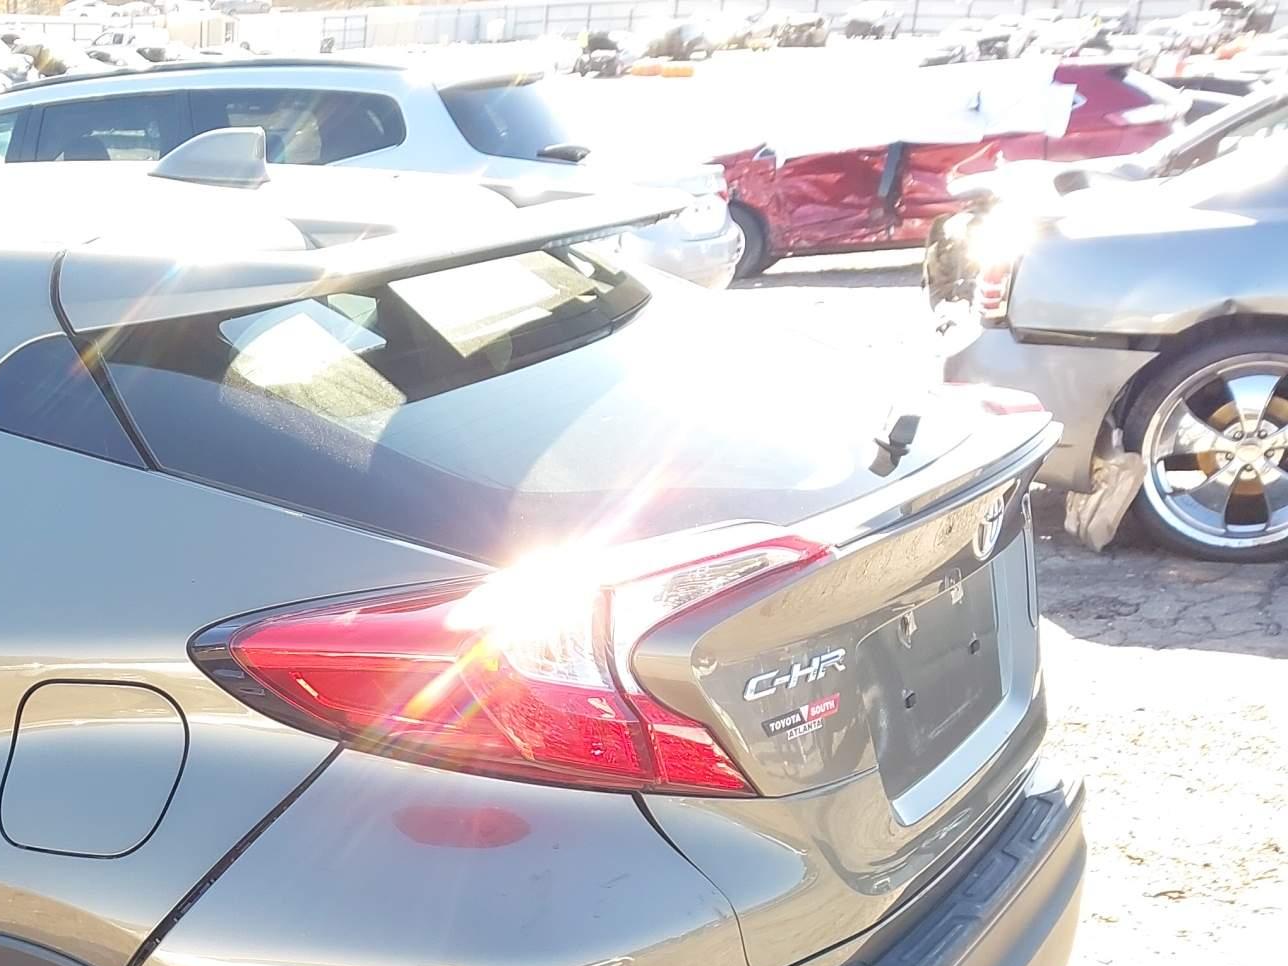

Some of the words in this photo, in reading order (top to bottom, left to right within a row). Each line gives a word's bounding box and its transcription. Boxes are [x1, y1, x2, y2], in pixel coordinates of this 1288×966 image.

[744, 648, 846, 701] C-HR
[769, 713, 801, 732] TOYOTA
[810, 700, 836, 717] SOUTH
[788, 718, 823, 738] ATLANTA
